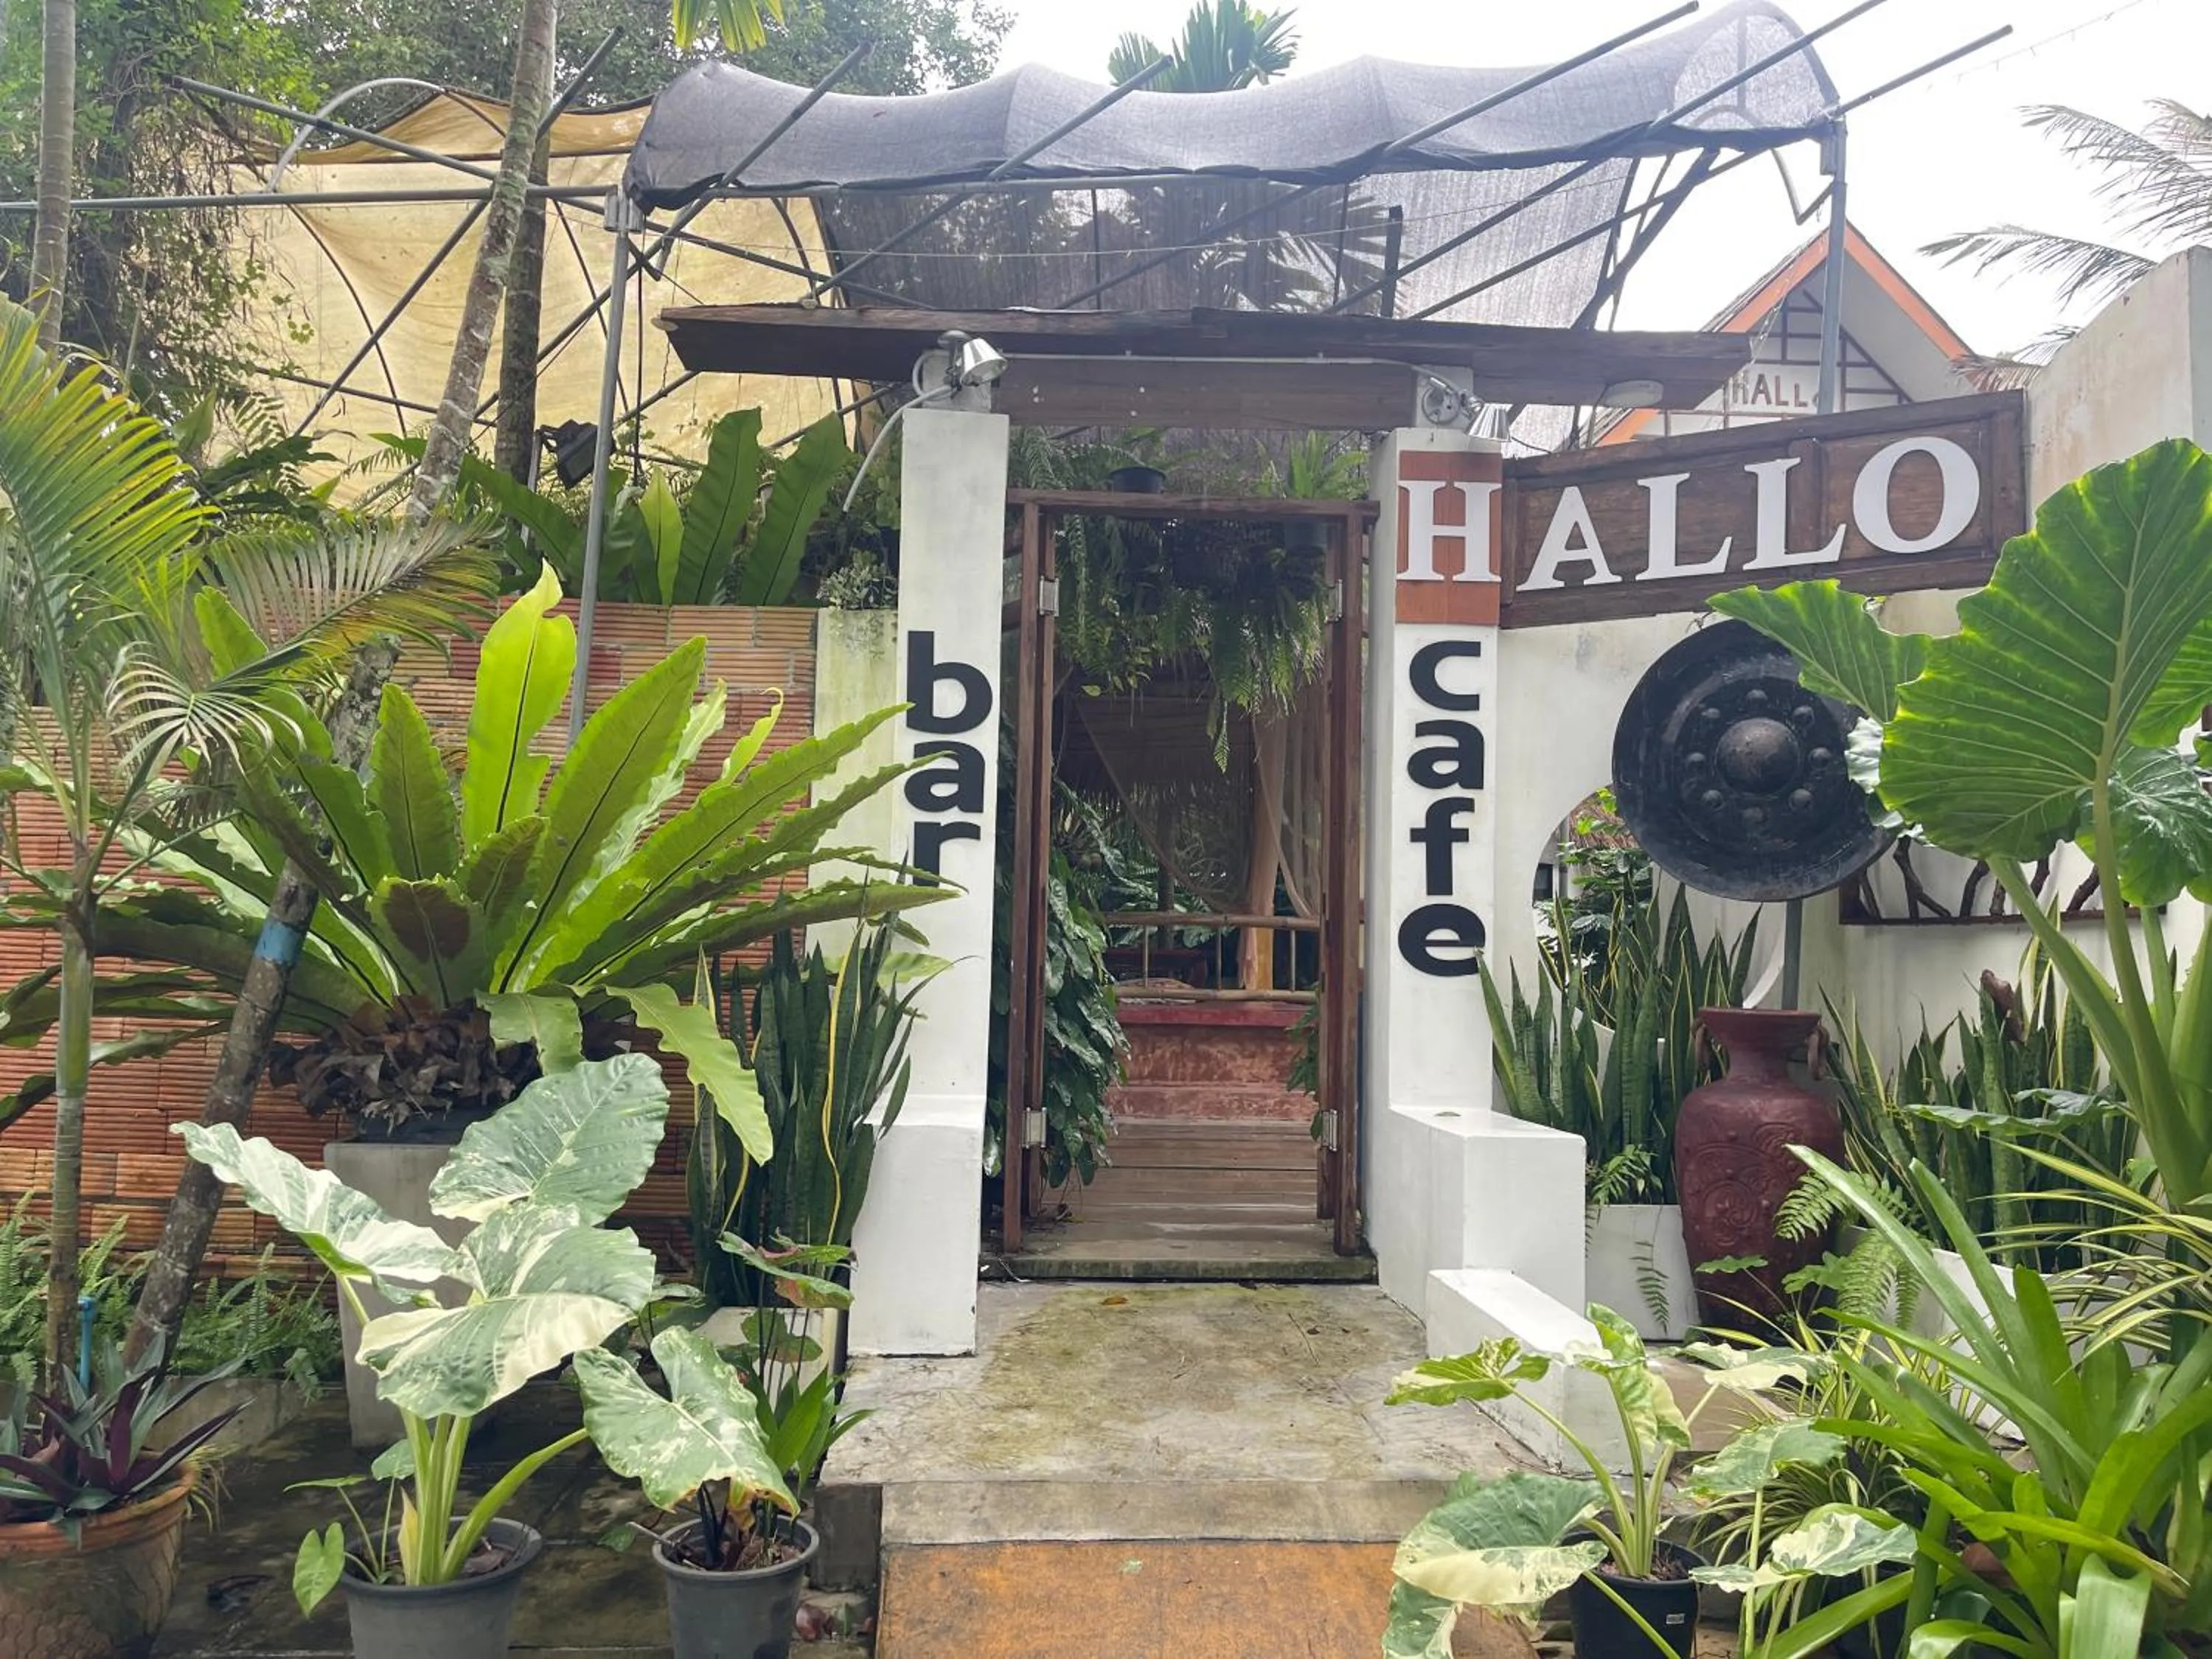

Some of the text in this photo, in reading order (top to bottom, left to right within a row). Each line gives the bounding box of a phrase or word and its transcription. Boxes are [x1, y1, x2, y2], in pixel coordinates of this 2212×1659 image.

[1397, 437, 1980, 591] HALLO
[904, 630, 992, 888] bar
[1397, 640, 1486, 977] cafe
